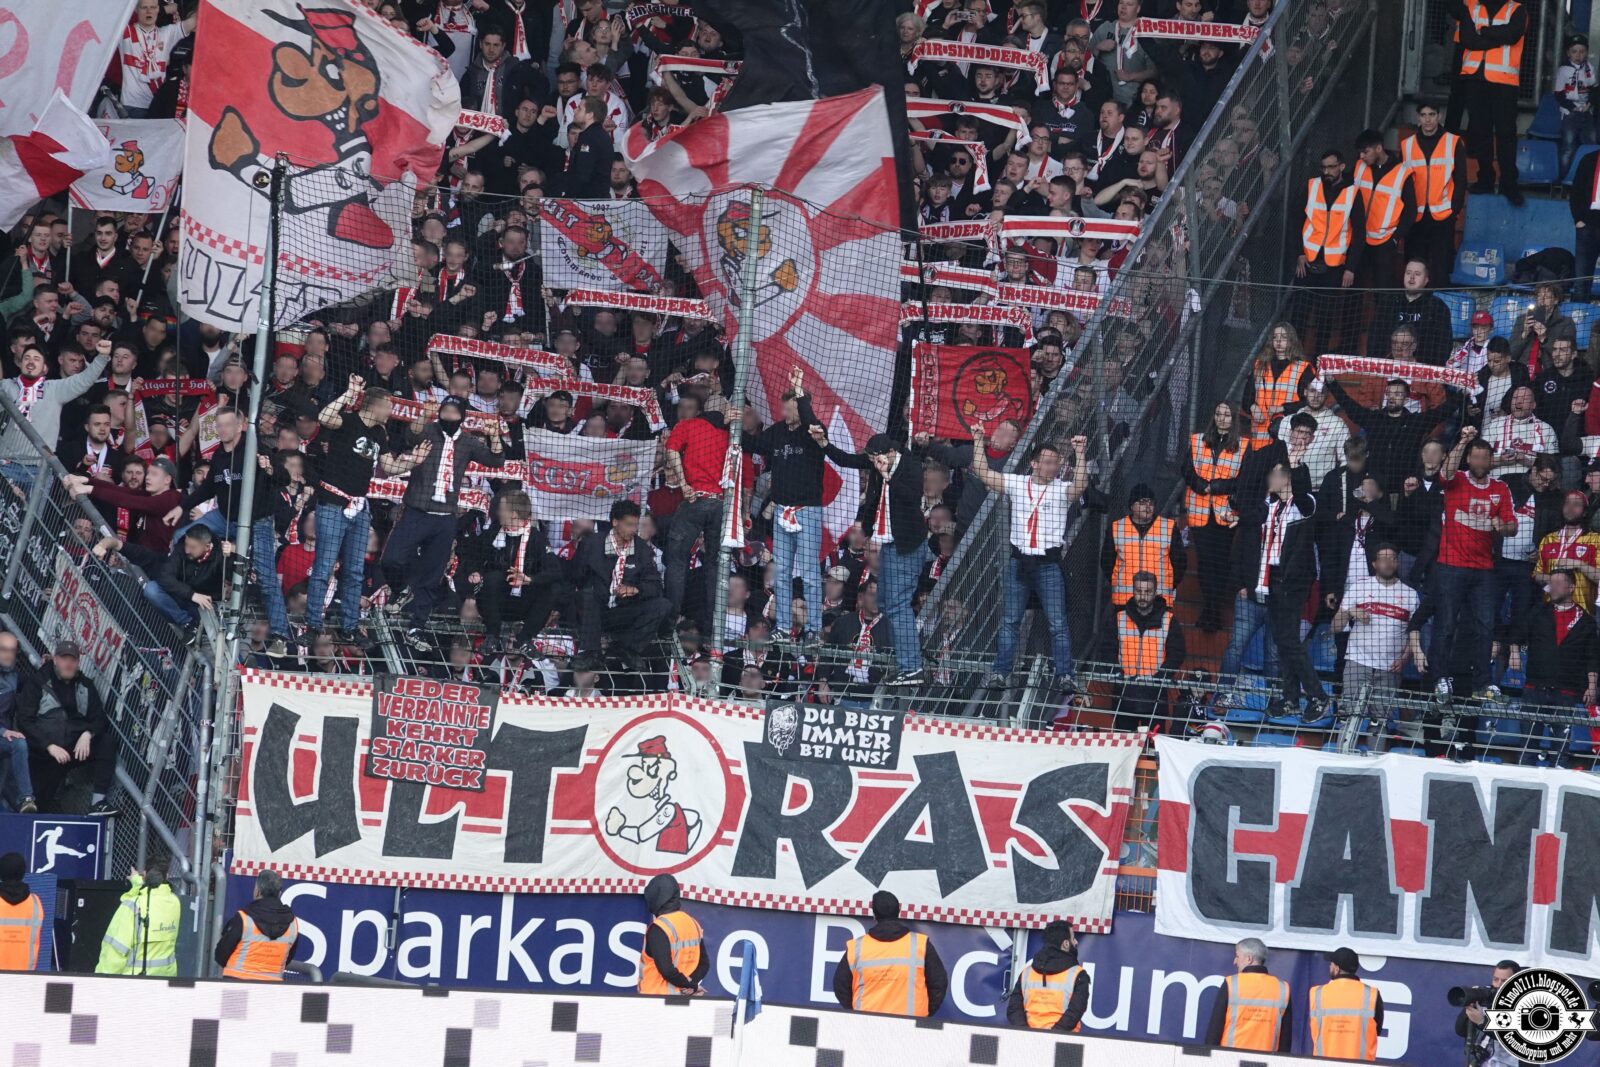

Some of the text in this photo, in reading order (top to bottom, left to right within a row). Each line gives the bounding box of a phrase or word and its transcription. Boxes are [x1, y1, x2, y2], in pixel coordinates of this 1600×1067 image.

[1157, 20, 1197, 35] SIND
[1200, 24, 1233, 38] DER
[948, 43, 986, 60] SIND
[989, 48, 1020, 64] DER
[953, 223, 980, 238] DER
[393, 678, 481, 705] JEDER
[378, 691, 491, 729] VERBANNTE
[803, 707, 895, 731] DU BIST
[386, 719, 479, 747] KEHRT
[801, 724, 892, 750] IMMER
[799, 743, 892, 766] BEI UNS!
[372, 757, 482, 789] ZURÜCK
[279, 882, 770, 1000] Sparkase
